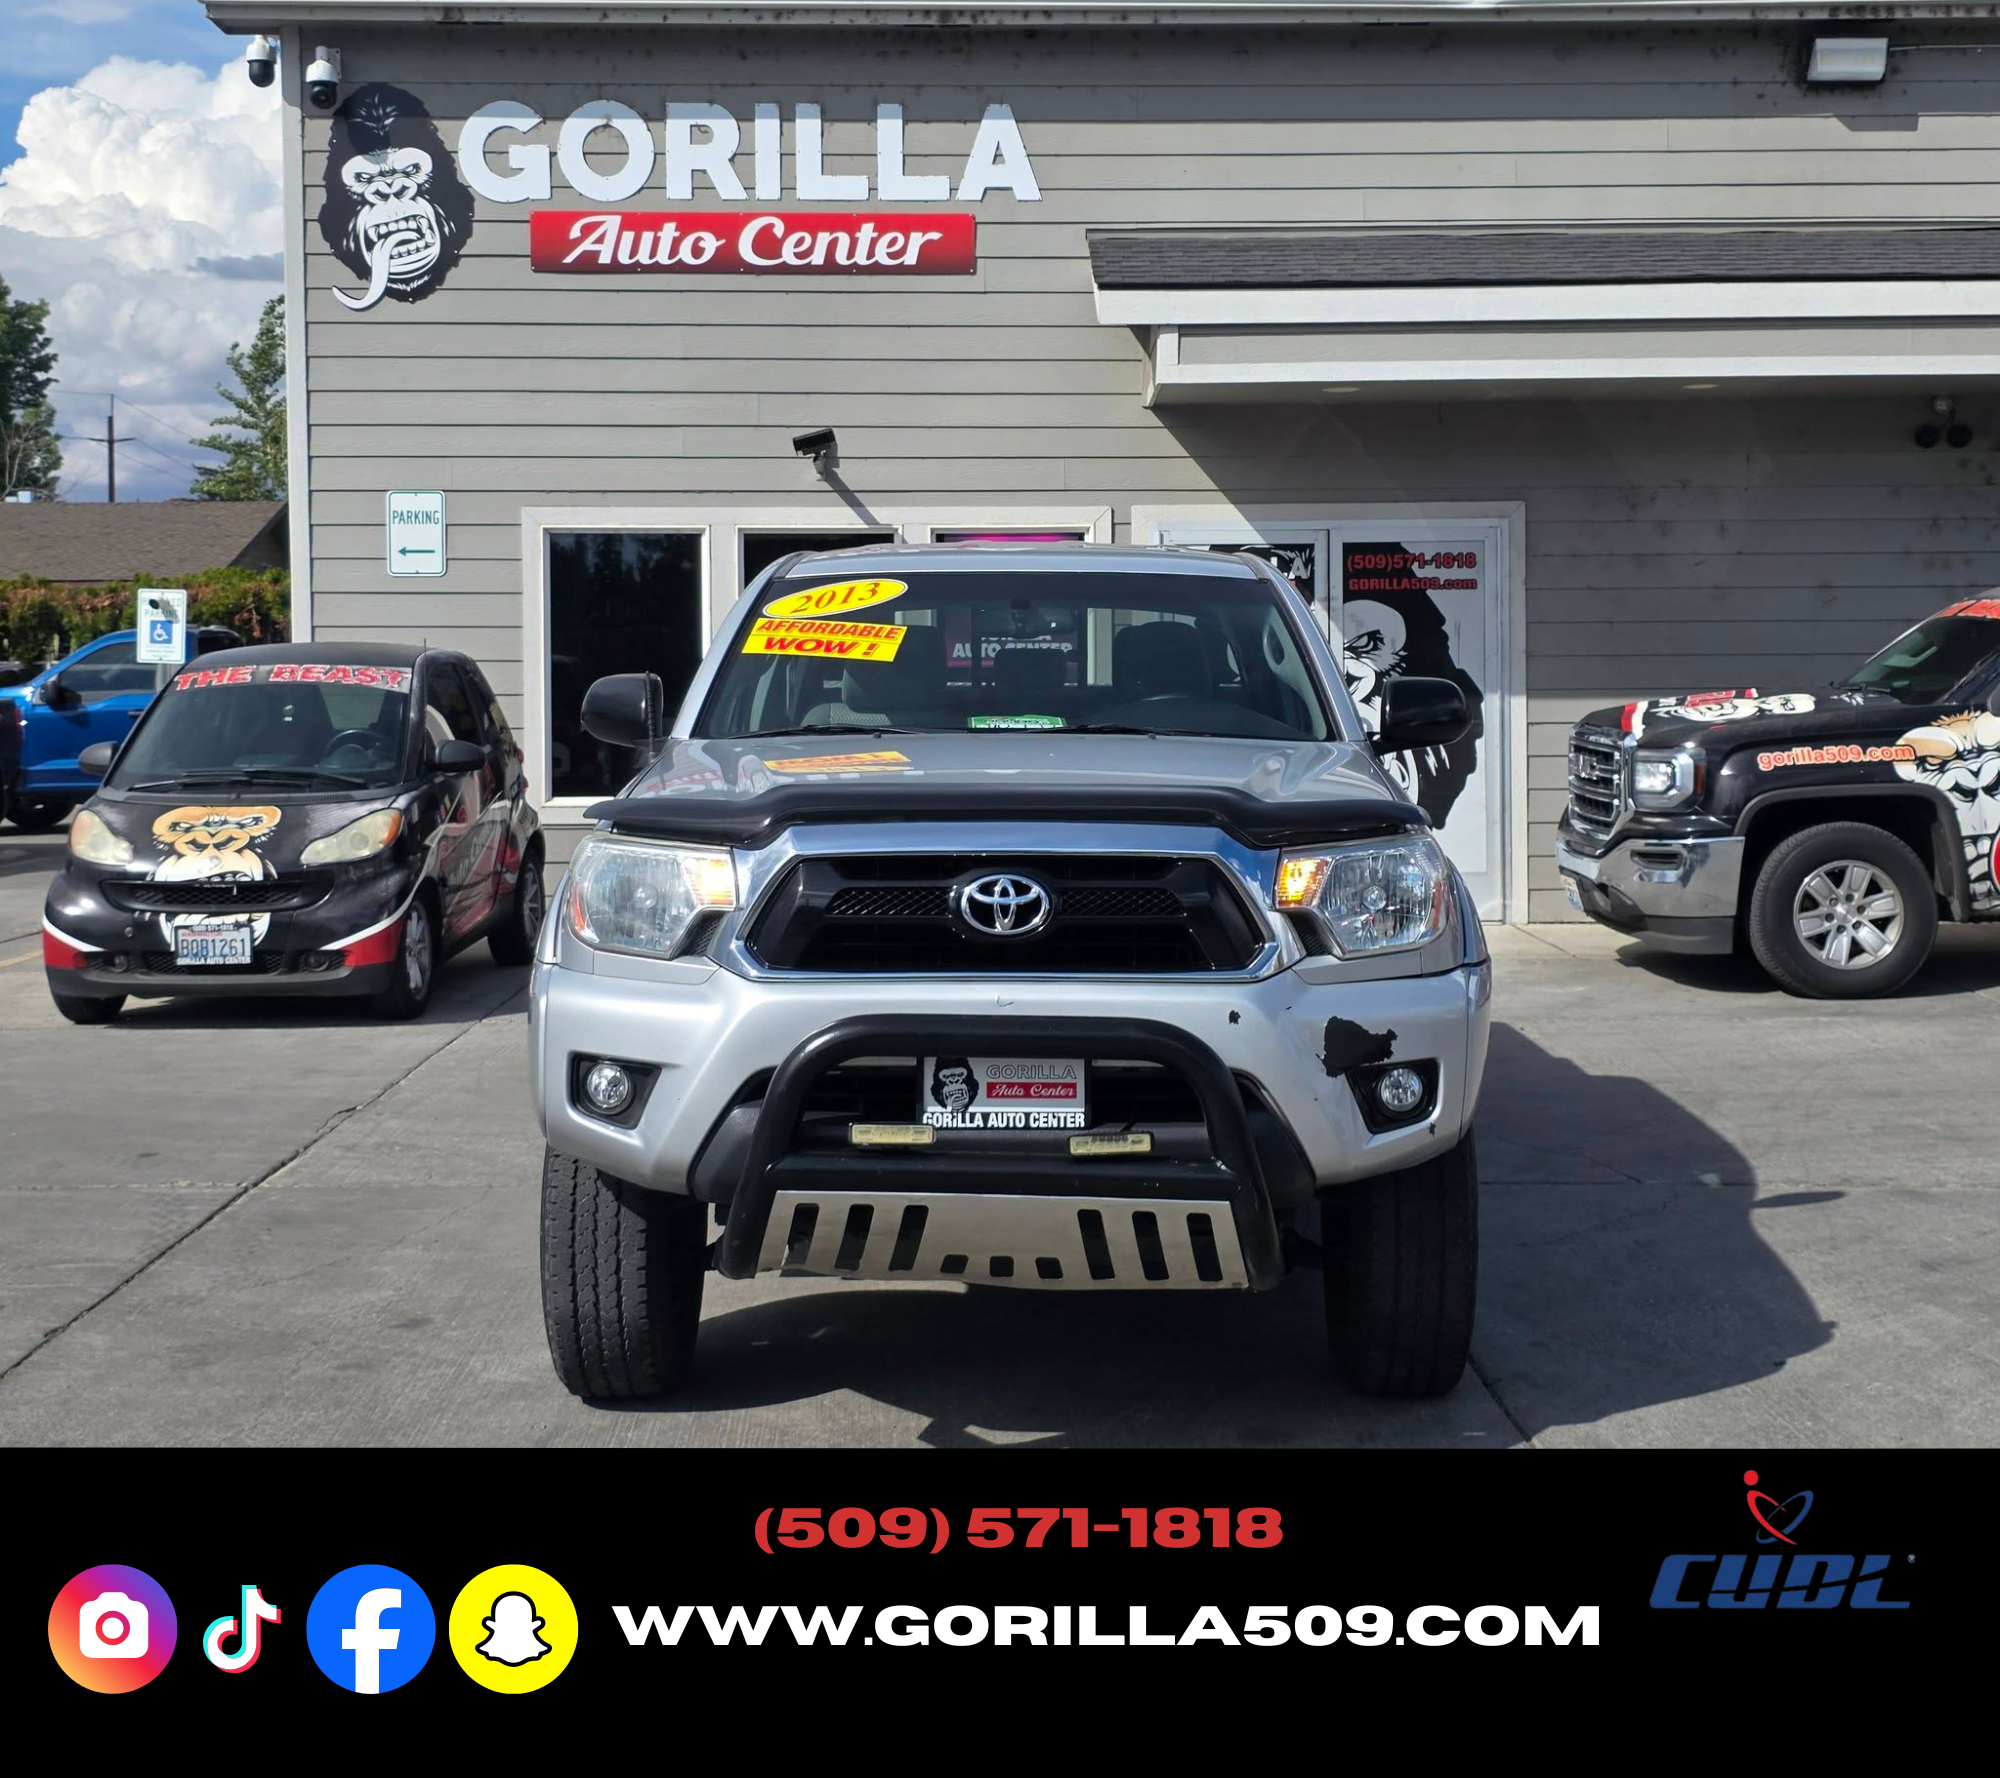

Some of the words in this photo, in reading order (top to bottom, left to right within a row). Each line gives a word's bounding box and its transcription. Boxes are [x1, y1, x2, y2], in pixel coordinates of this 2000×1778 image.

[458, 99, 1043, 203] GORILLA
[562, 214, 725, 266] Auto
[738, 216, 943, 266] Center
[392, 510, 440, 525] PARKING
[1347, 552, 1477, 572] (509)571-1818
[1348, 577, 1477, 591] GORILLA509.com
[789, 582, 881, 614] 2013
[757, 620, 902, 640] AFFORDABLE
[173, 665, 257, 690] THE
[268, 664, 412, 688] BEAST
[1757, 744, 1917, 771] gorilla509.com
[180, 939, 246, 957] BQB1261
[986, 1064, 1077, 1079] GORILLA
[991, 1083, 1026, 1097] Auto
[1029, 1083, 1076, 1097] Center
[923, 1112, 984, 1128] GORILLA
[987, 1112, 1025, 1128] AUTO
[1029, 1112, 1085, 1128] CENTER
